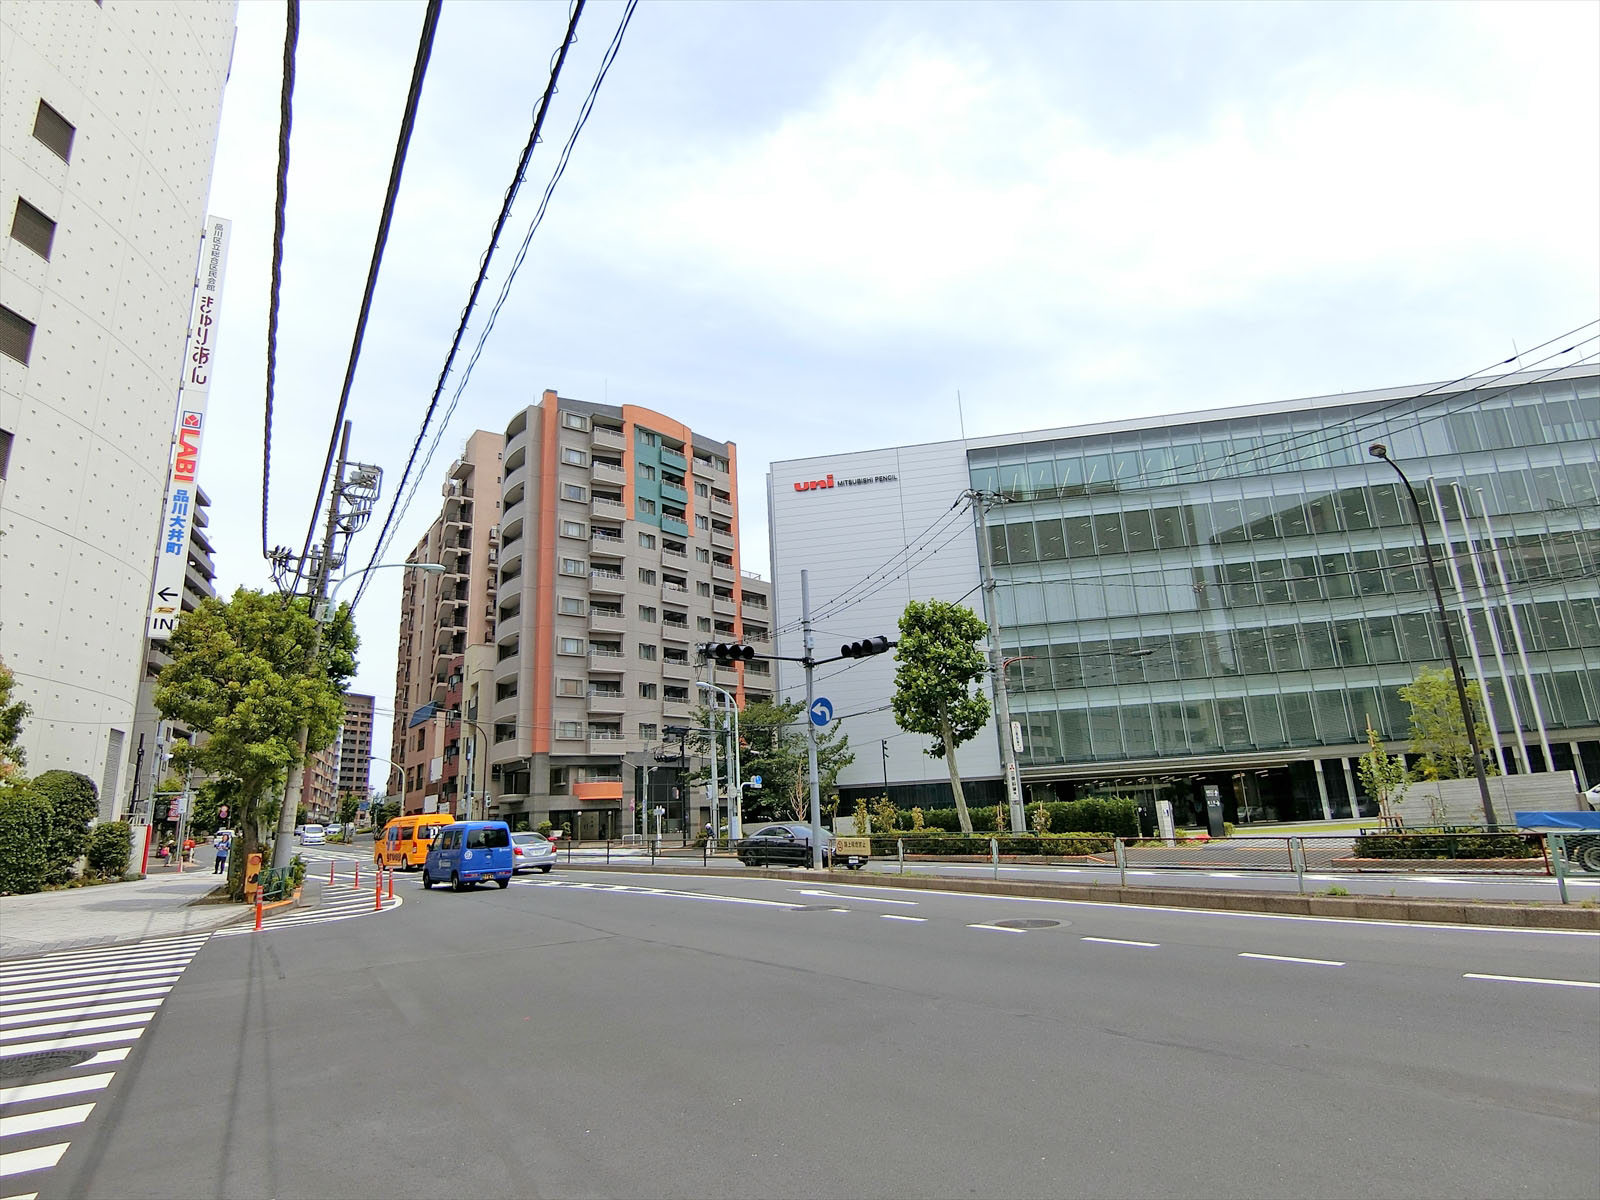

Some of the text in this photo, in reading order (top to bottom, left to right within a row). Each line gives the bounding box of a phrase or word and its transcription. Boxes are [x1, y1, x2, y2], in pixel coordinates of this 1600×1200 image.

[174, 428, 201, 484] LABI
[793, 474, 898, 492] uni MITSUBISHI PENCIL
[165, 489, 190, 556] 品川大井町
[153, 618, 174, 631] IN
